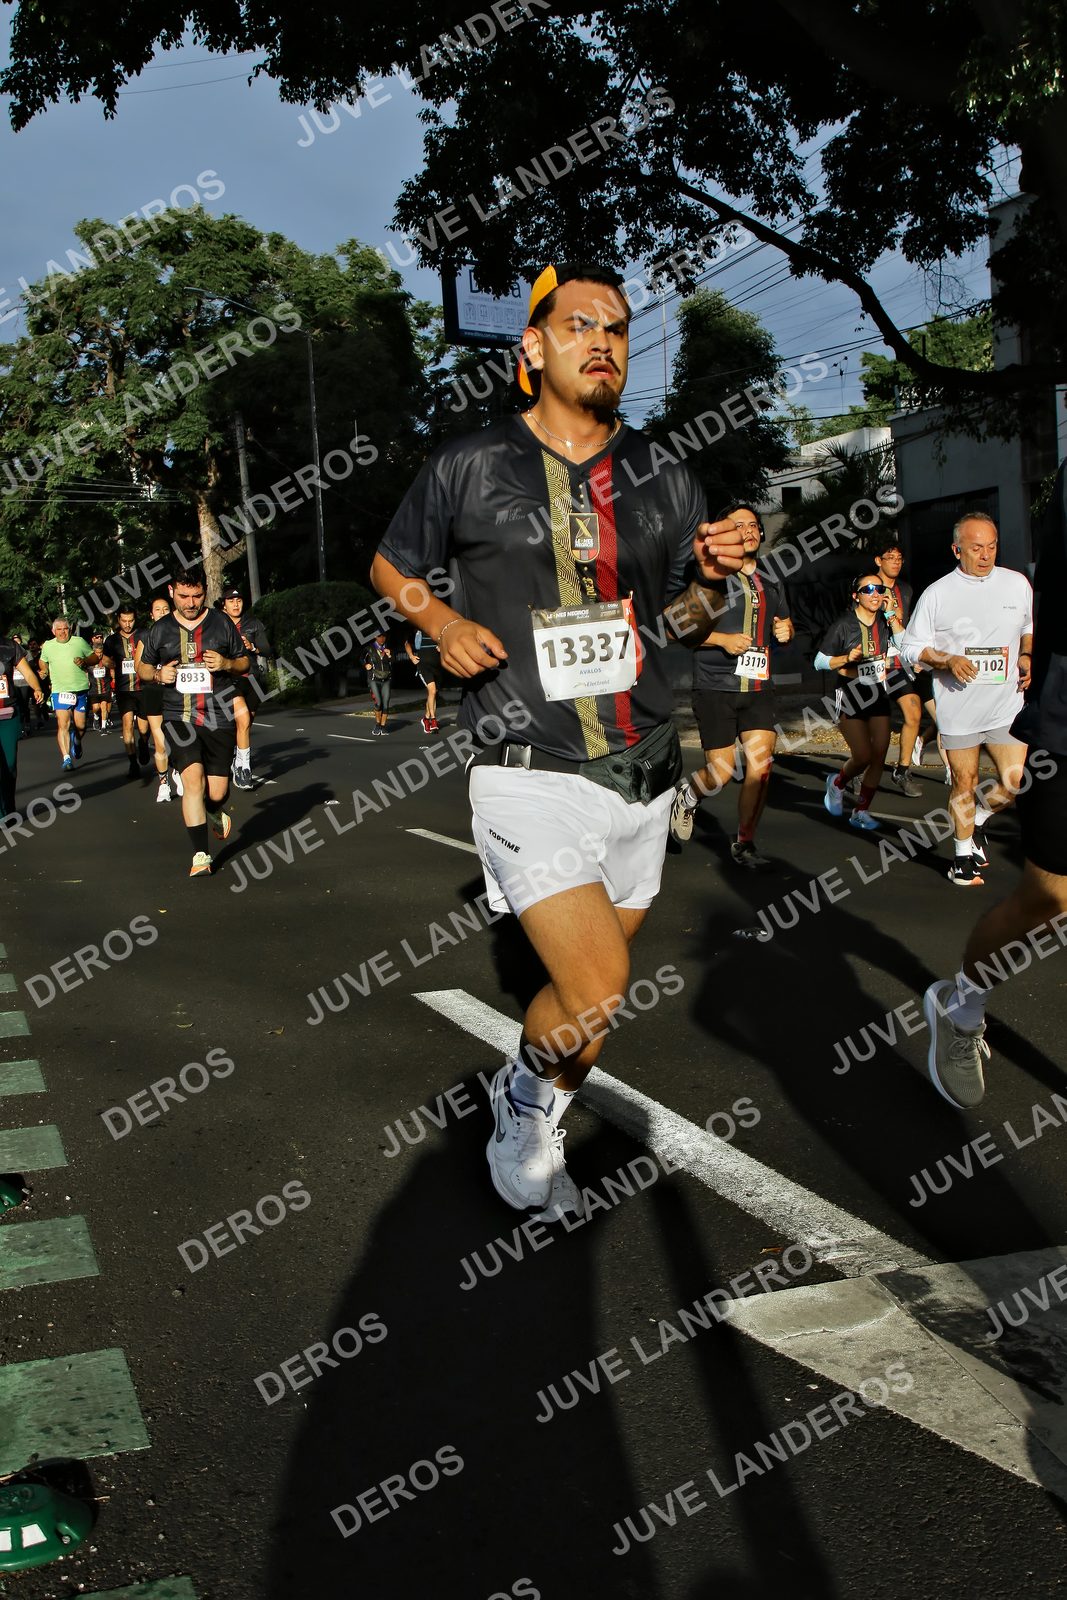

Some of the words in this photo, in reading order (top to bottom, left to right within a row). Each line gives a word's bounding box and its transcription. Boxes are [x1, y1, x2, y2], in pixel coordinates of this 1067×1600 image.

[541, 630, 629, 669] 13337
[740, 655, 767, 668] 13119
[860, 662, 885, 677] 12965
[180, 672, 205, 683] 8933
